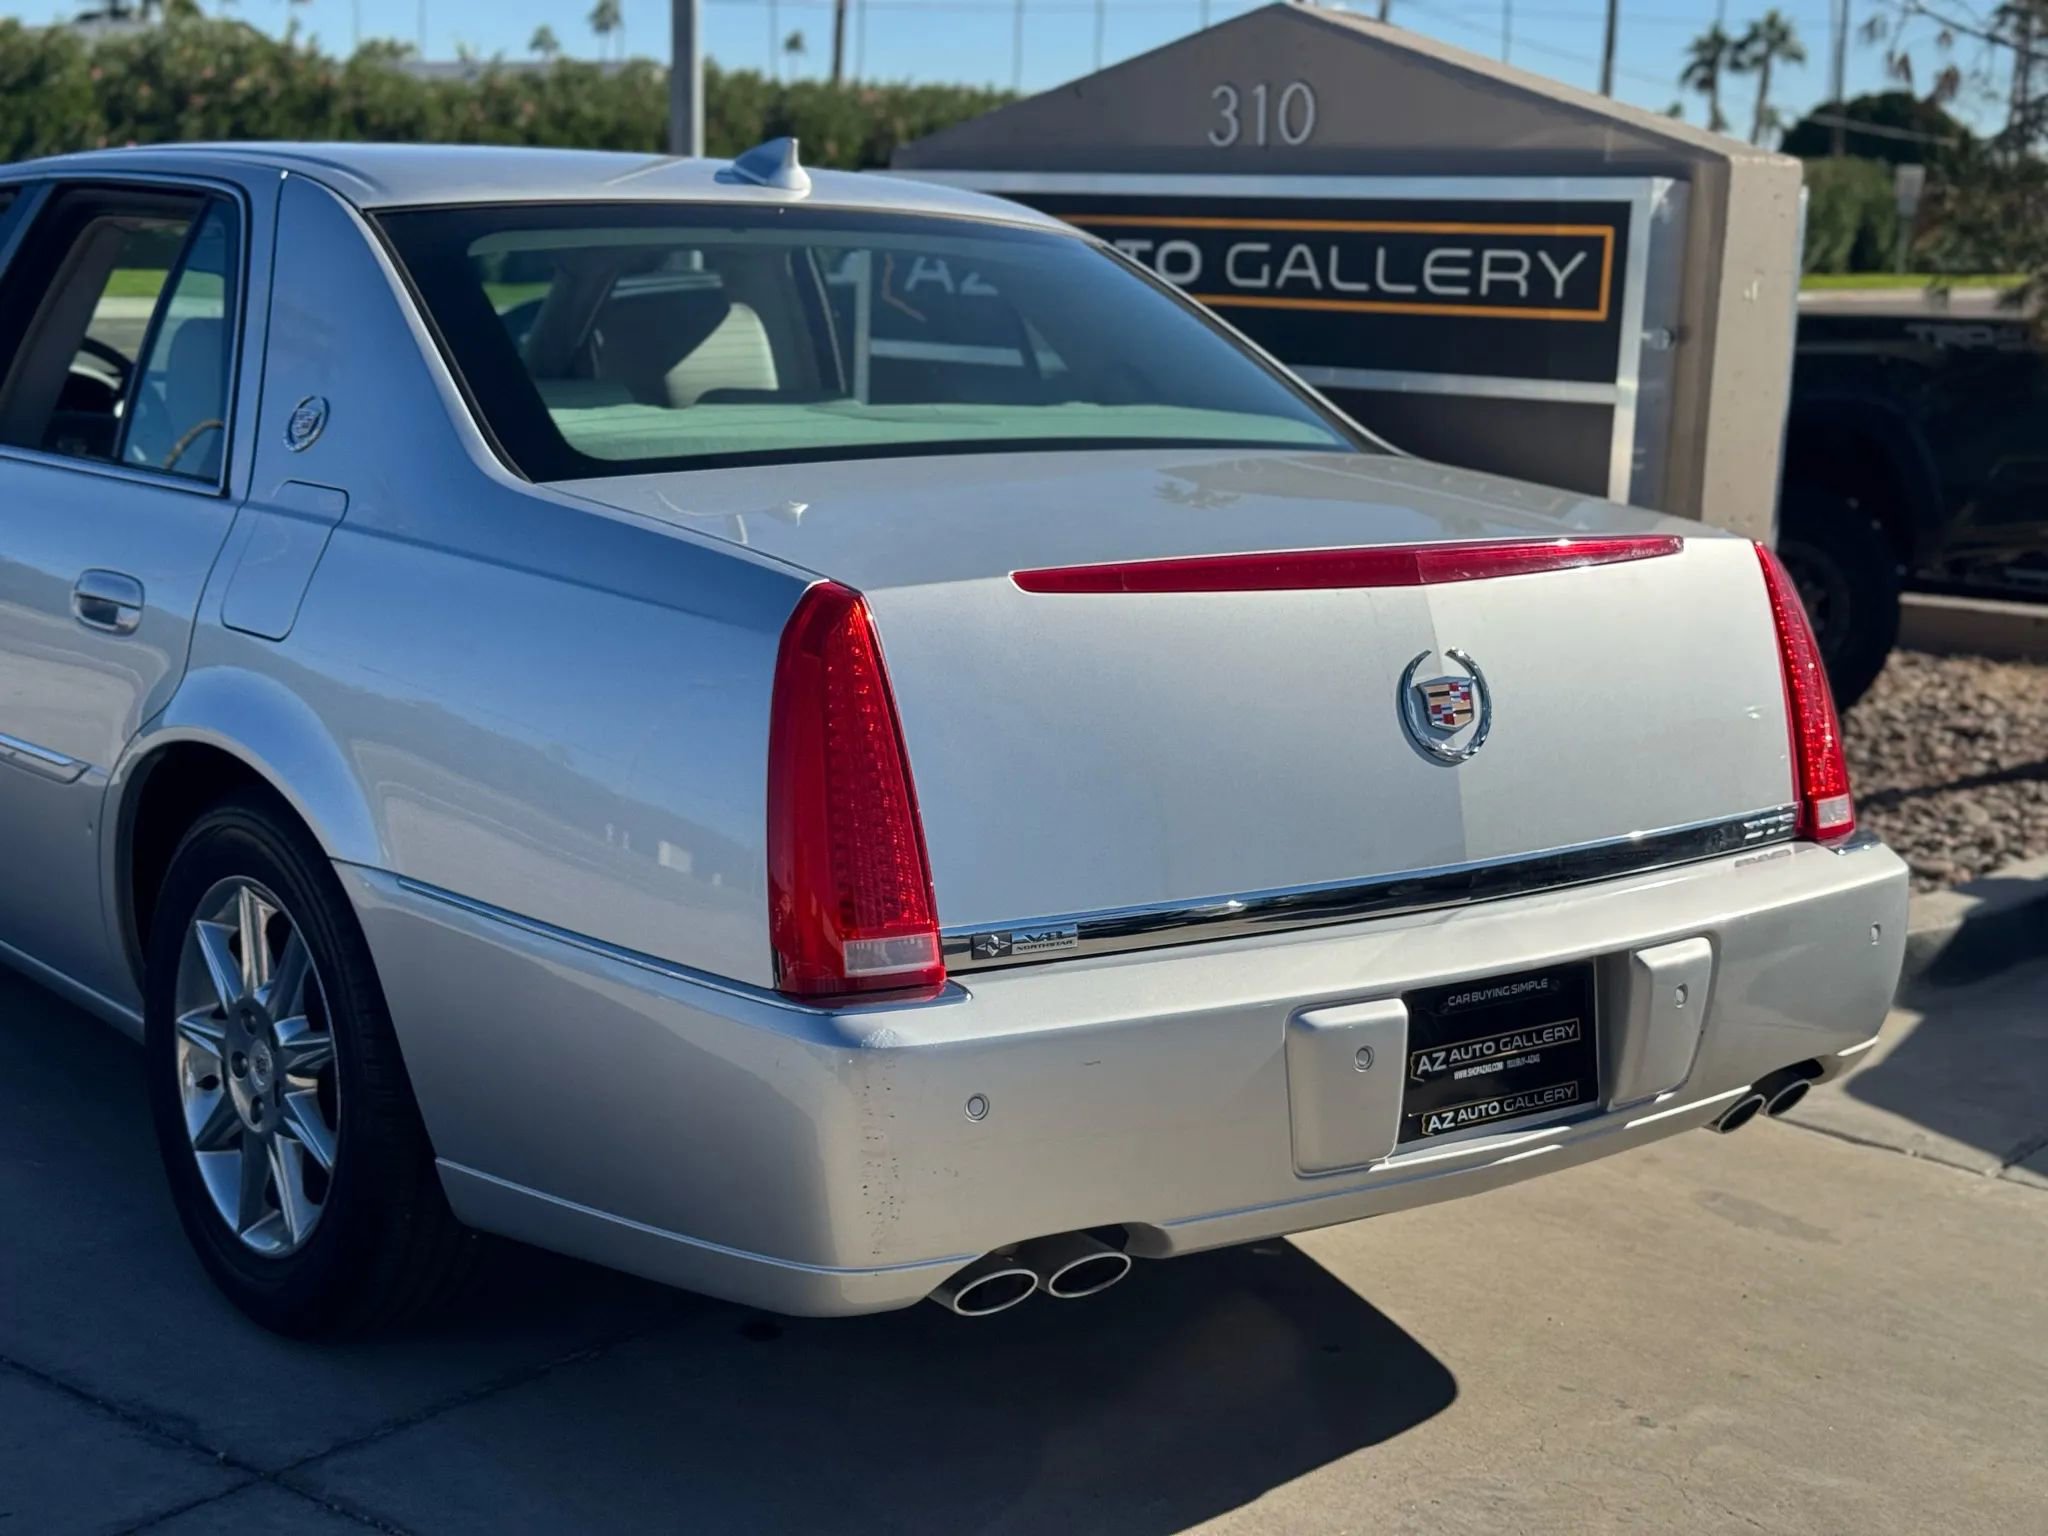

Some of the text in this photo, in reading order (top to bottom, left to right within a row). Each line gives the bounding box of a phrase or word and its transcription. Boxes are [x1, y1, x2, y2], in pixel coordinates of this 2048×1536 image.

[1208, 82, 1317, 148] 310
[1114, 238, 1203, 287] TO
[1225, 240, 1587, 299] GALLERY
[1416, 1051, 1447, 1075] AZ
[1449, 1041, 1495, 1062] AUTO
[1499, 1024, 1576, 1052] GALLERY
[1427, 1086, 1574, 1133] AZ AUTO GALLERY
